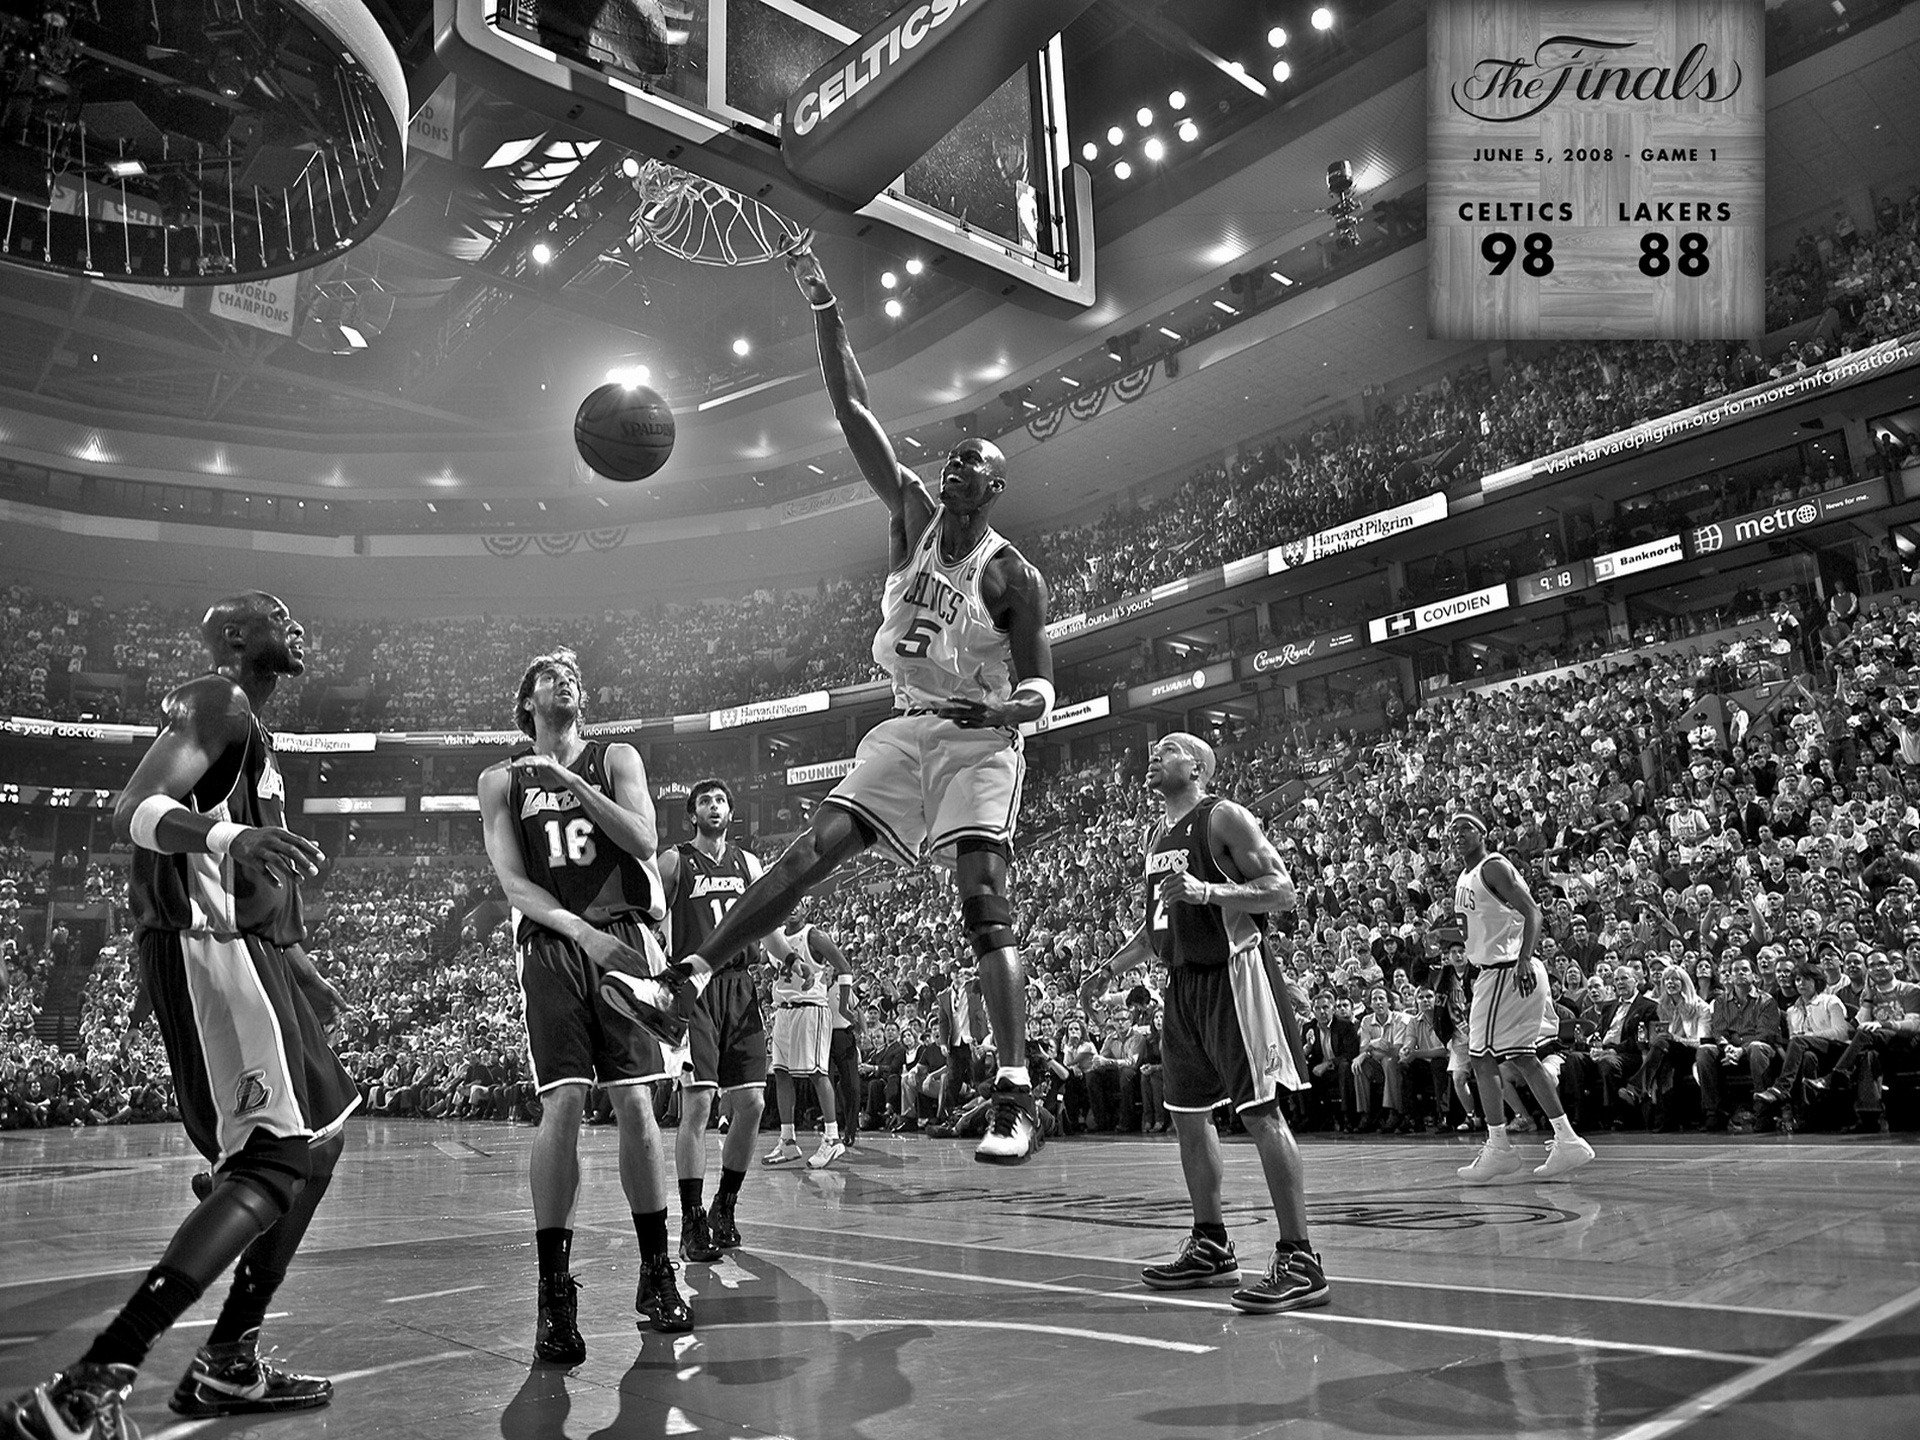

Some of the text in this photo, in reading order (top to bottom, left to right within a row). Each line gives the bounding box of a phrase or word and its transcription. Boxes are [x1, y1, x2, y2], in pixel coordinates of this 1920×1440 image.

[794, 0, 958, 136] CELTICS
[218, 291, 289, 322] CHAMPIONS
[235, 282, 277, 304] WORLD
[1546, 346, 1914, 475] Visit harvardpilgrim.org for more information.
[1312, 523, 1364, 547] Harvard
[1365, 515, 1413, 536] Pilgrim
[1620, 542, 1682, 566] Banknorth
[1540, 571, 1572, 591] 9:18
[1423, 594, 1490, 623] COVIDIEN
[895, 618, 942, 658] 5
[1051, 705, 1092, 723] Banknorth
[23, 724, 56, 736] your
[57, 726, 105, 739] doctor.
[544, 818, 598, 868] 16
[1146, 849, 1190, 875] AKERS
[689, 874, 746, 899] LAKERS
